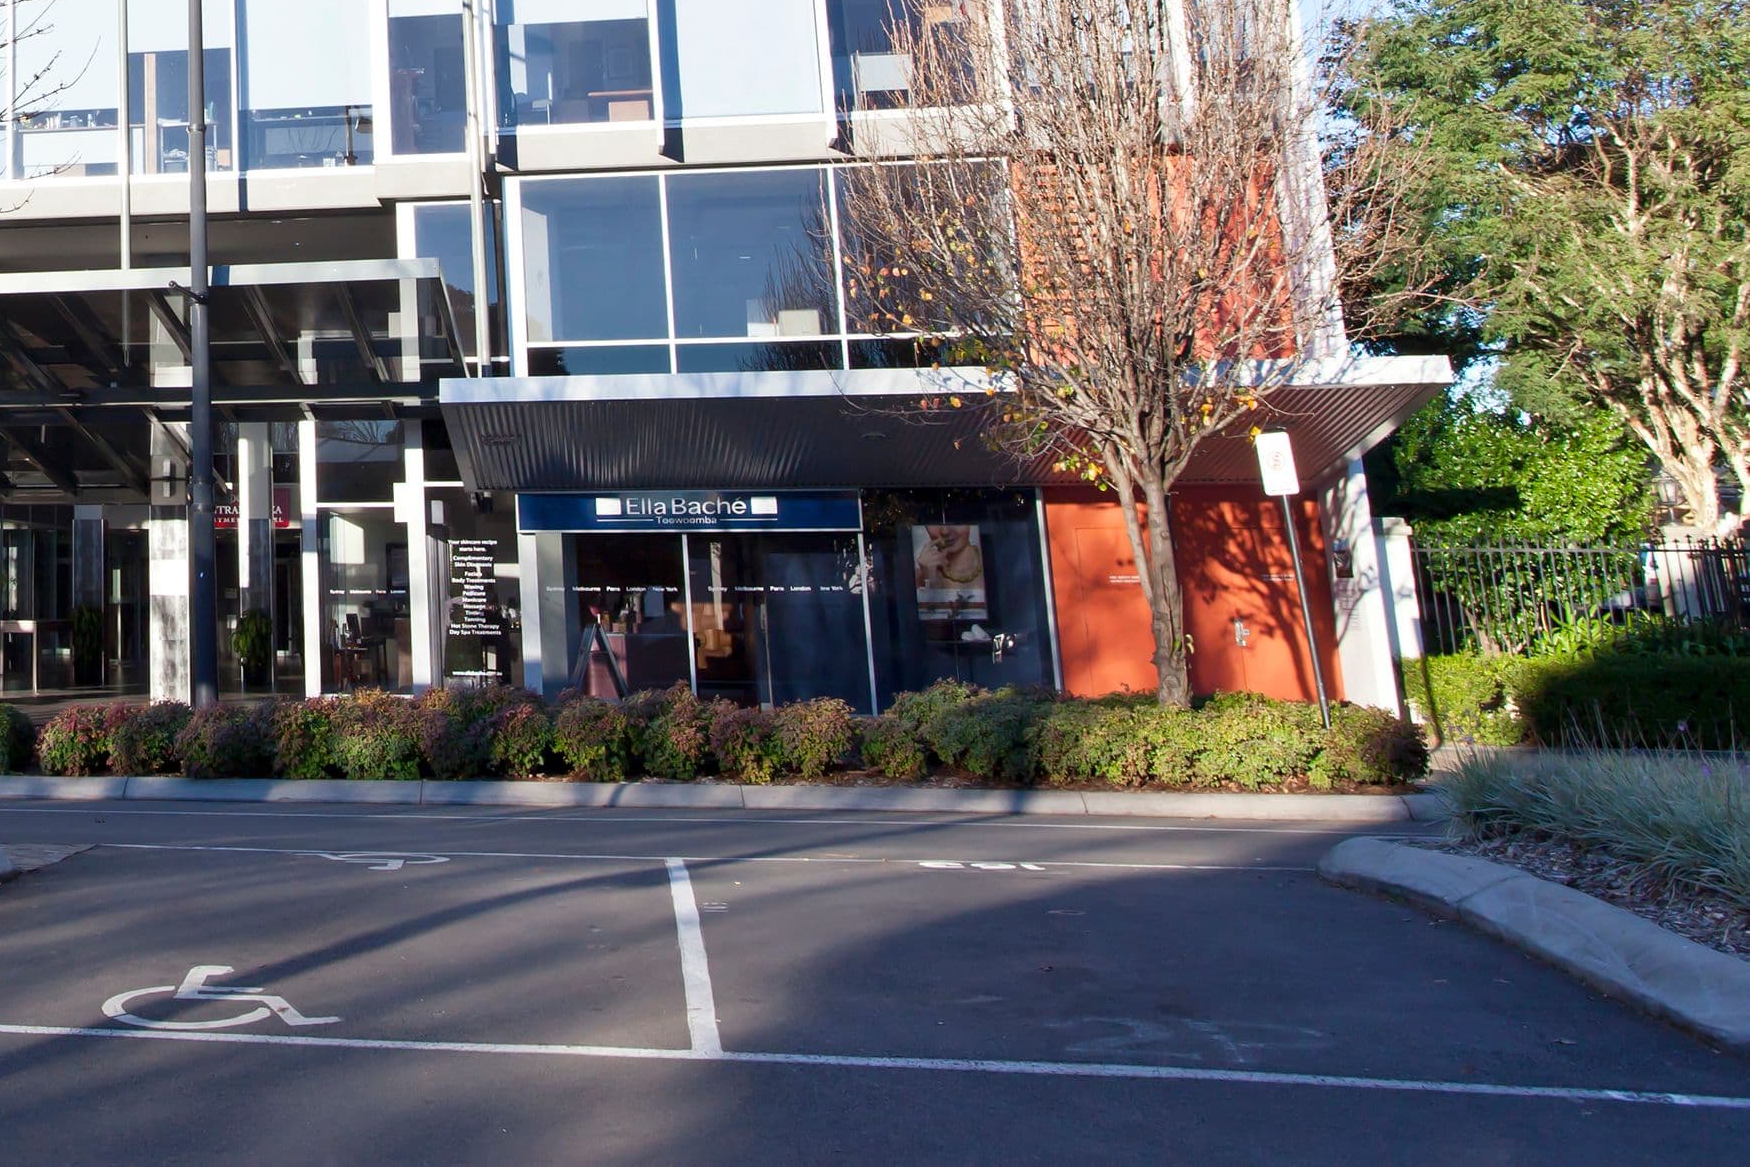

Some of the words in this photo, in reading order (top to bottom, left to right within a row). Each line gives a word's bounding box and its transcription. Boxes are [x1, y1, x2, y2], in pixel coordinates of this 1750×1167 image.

[626, 498, 667, 515] Ella
[671, 496, 748, 515] Baché
[656, 516, 718, 525] Toowoomba
